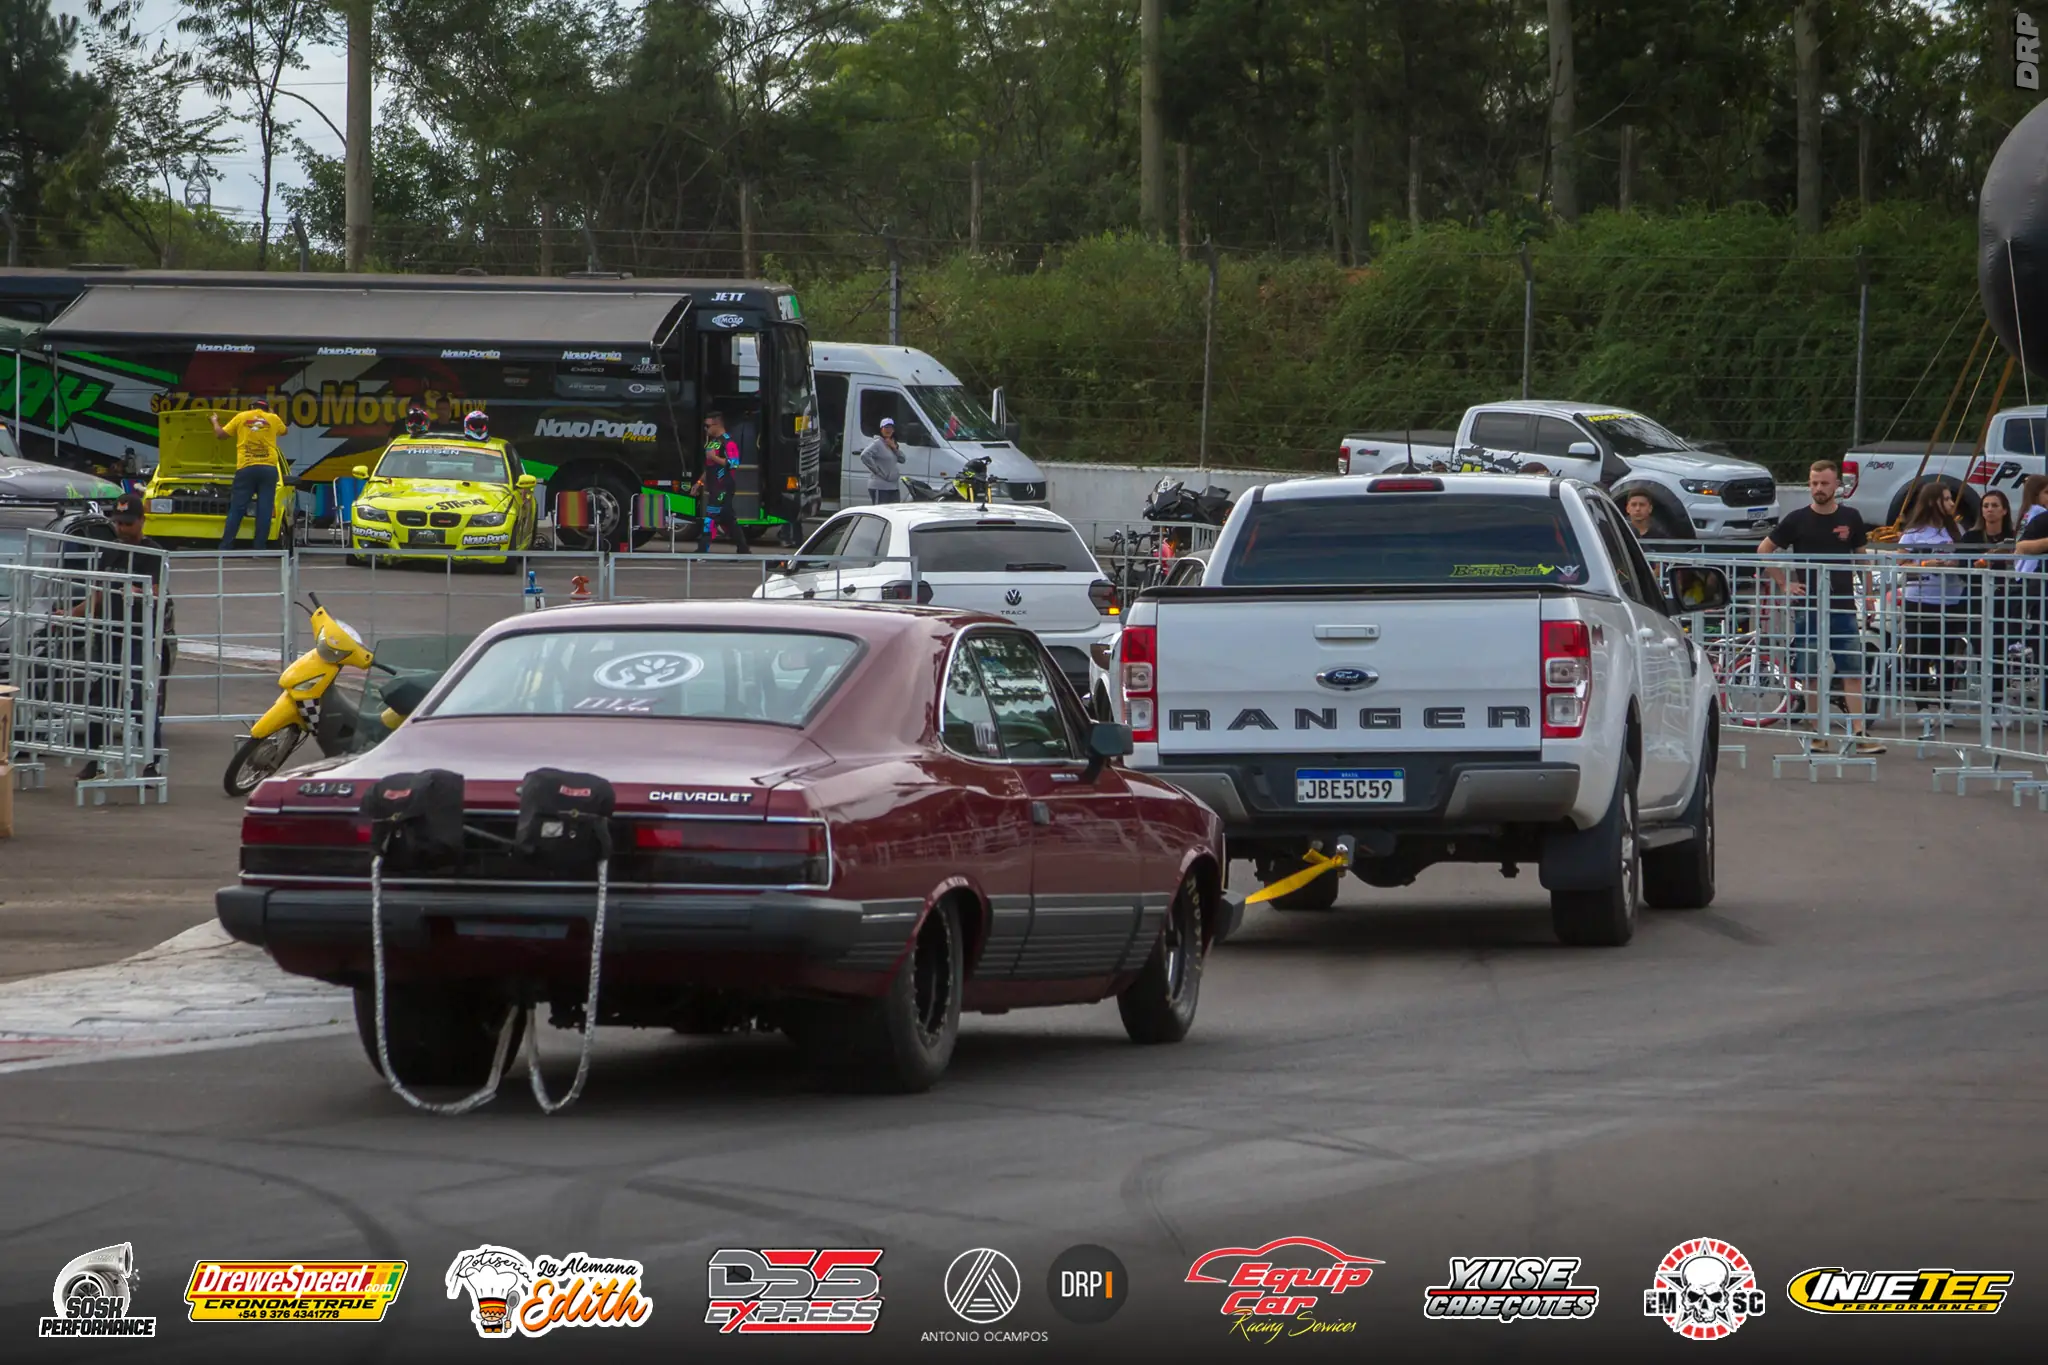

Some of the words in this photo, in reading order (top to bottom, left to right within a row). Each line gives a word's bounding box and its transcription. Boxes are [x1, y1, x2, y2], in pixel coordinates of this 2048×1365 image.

[711, 292, 746, 302] JETT
[1168, 706, 1531, 731] RANGER
[648, 790, 752, 802] CHEVROLET
[1305, 780, 1393, 799] JBE5C59
